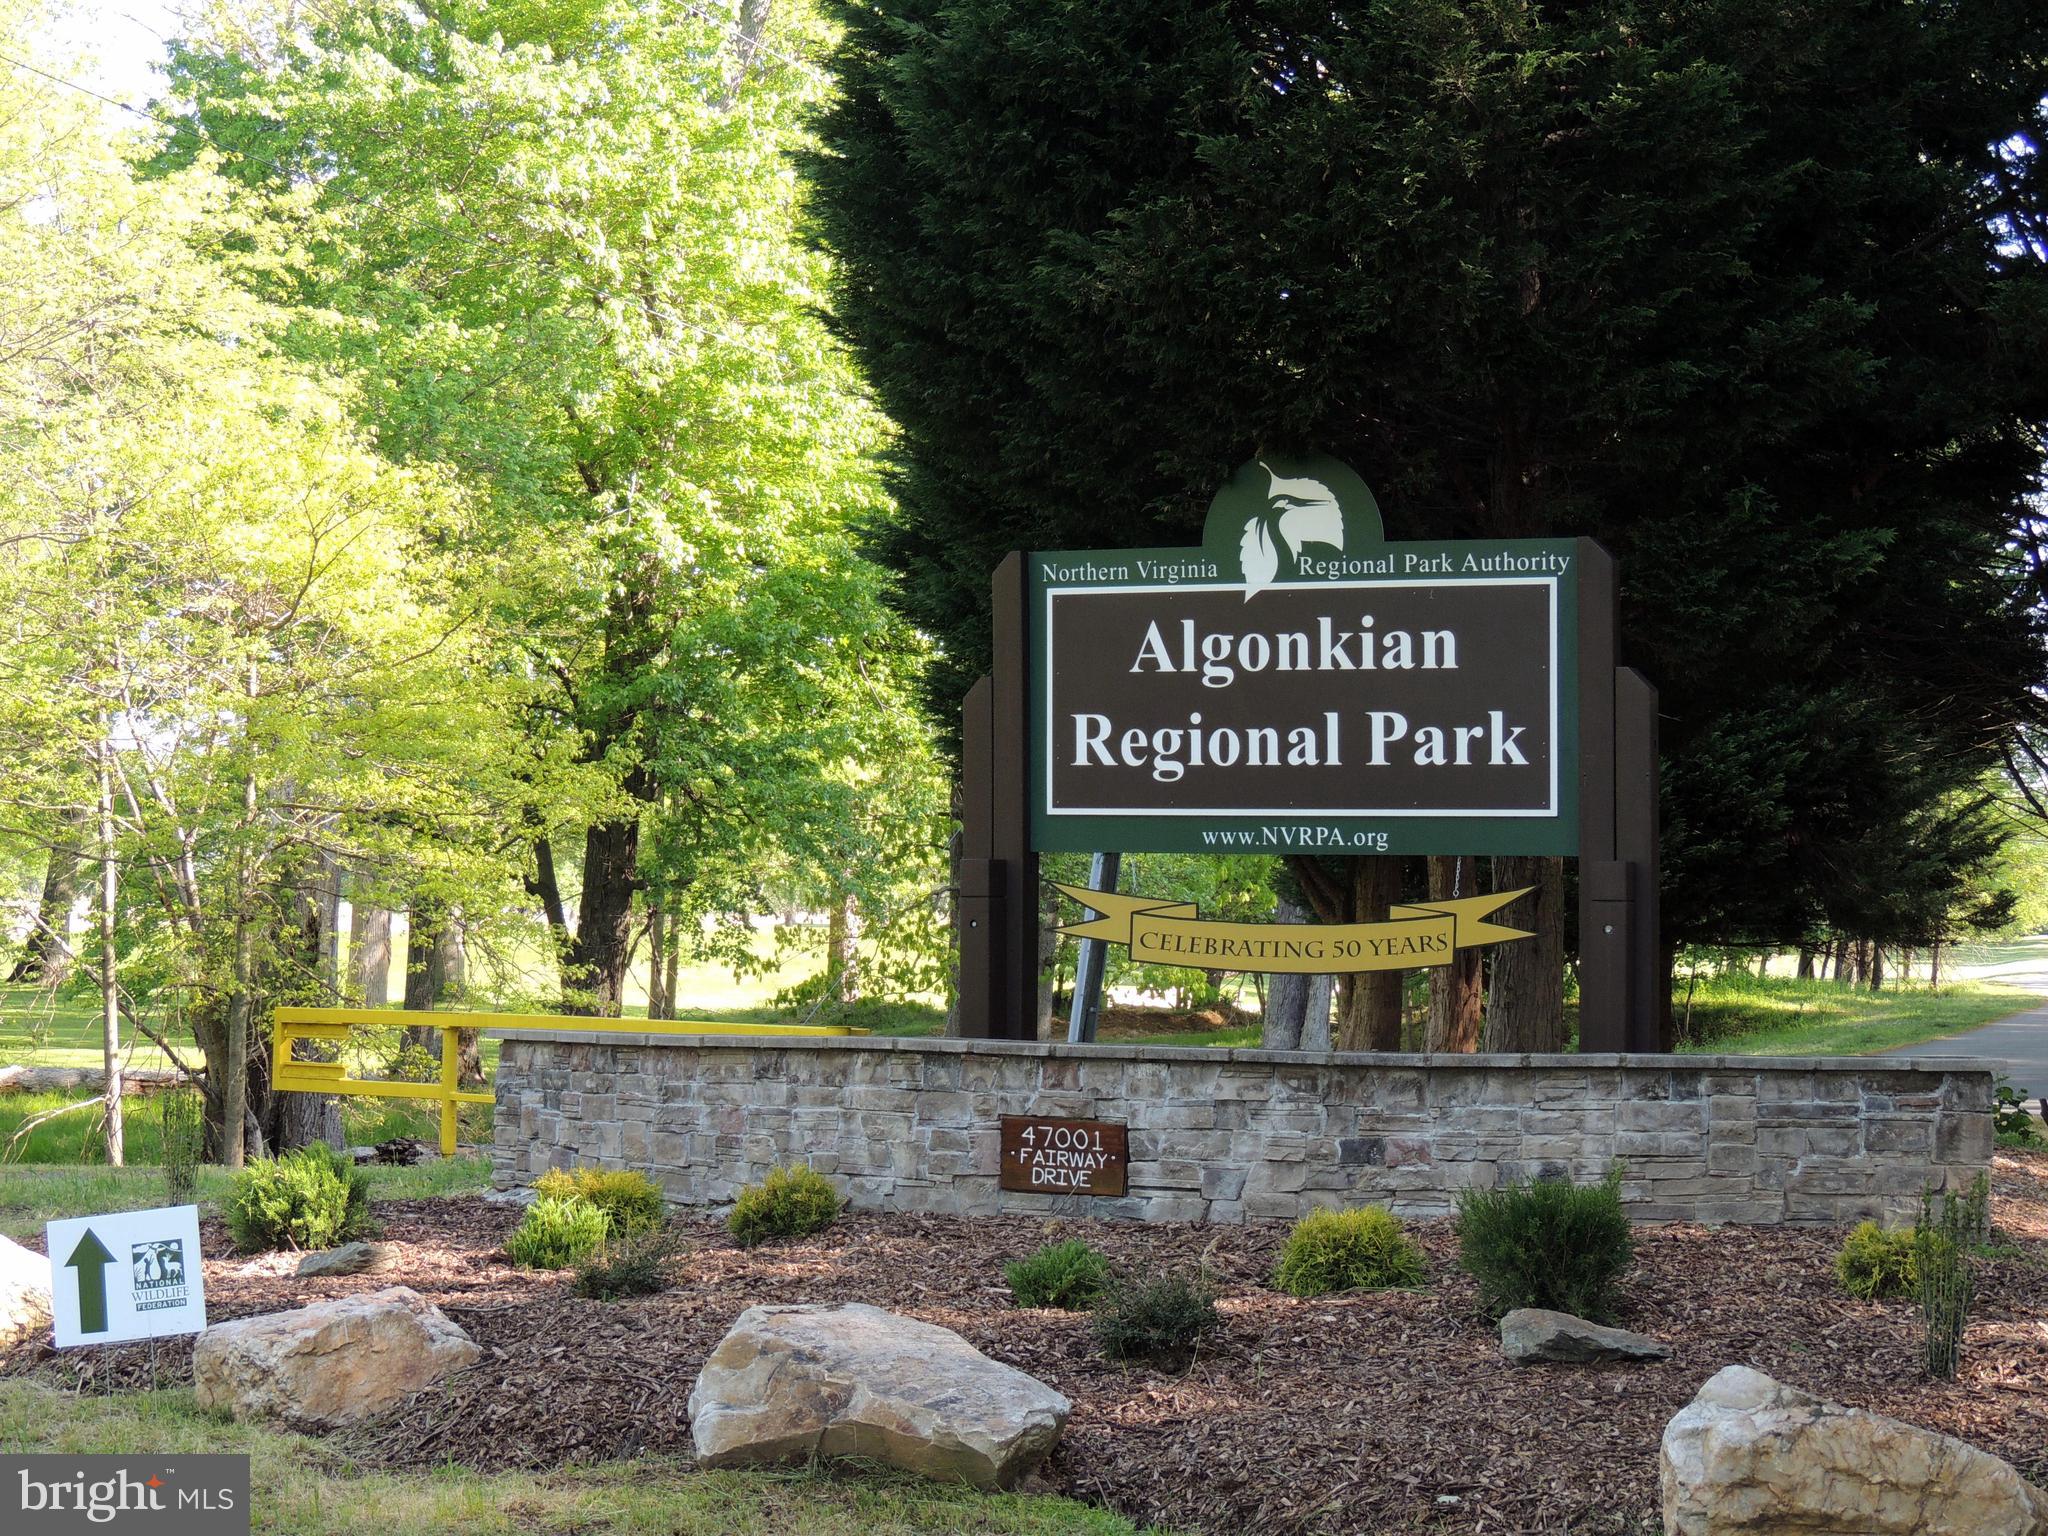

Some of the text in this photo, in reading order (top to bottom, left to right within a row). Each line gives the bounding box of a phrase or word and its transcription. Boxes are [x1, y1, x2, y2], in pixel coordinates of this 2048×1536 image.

[1042, 551, 1570, 583] Northern Virginia Regional Park Authority
[1129, 615, 1459, 688] Algonkian
[1070, 711, 1530, 782] Regional Park
[1202, 827, 1389, 851] www.NVRPA.org
[1139, 930, 1449, 959] CELEBRATING 50 YEARS
[1021, 1126, 1104, 1151] 47001
[1020, 1147, 1108, 1169] FAIRWAY
[1032, 1167, 1092, 1187] DRIVE
[131, 1286, 190, 1302] WILDLIFE
[136, 1278, 184, 1290] NATIONAL
[137, 1299, 186, 1311] FEDERATION
